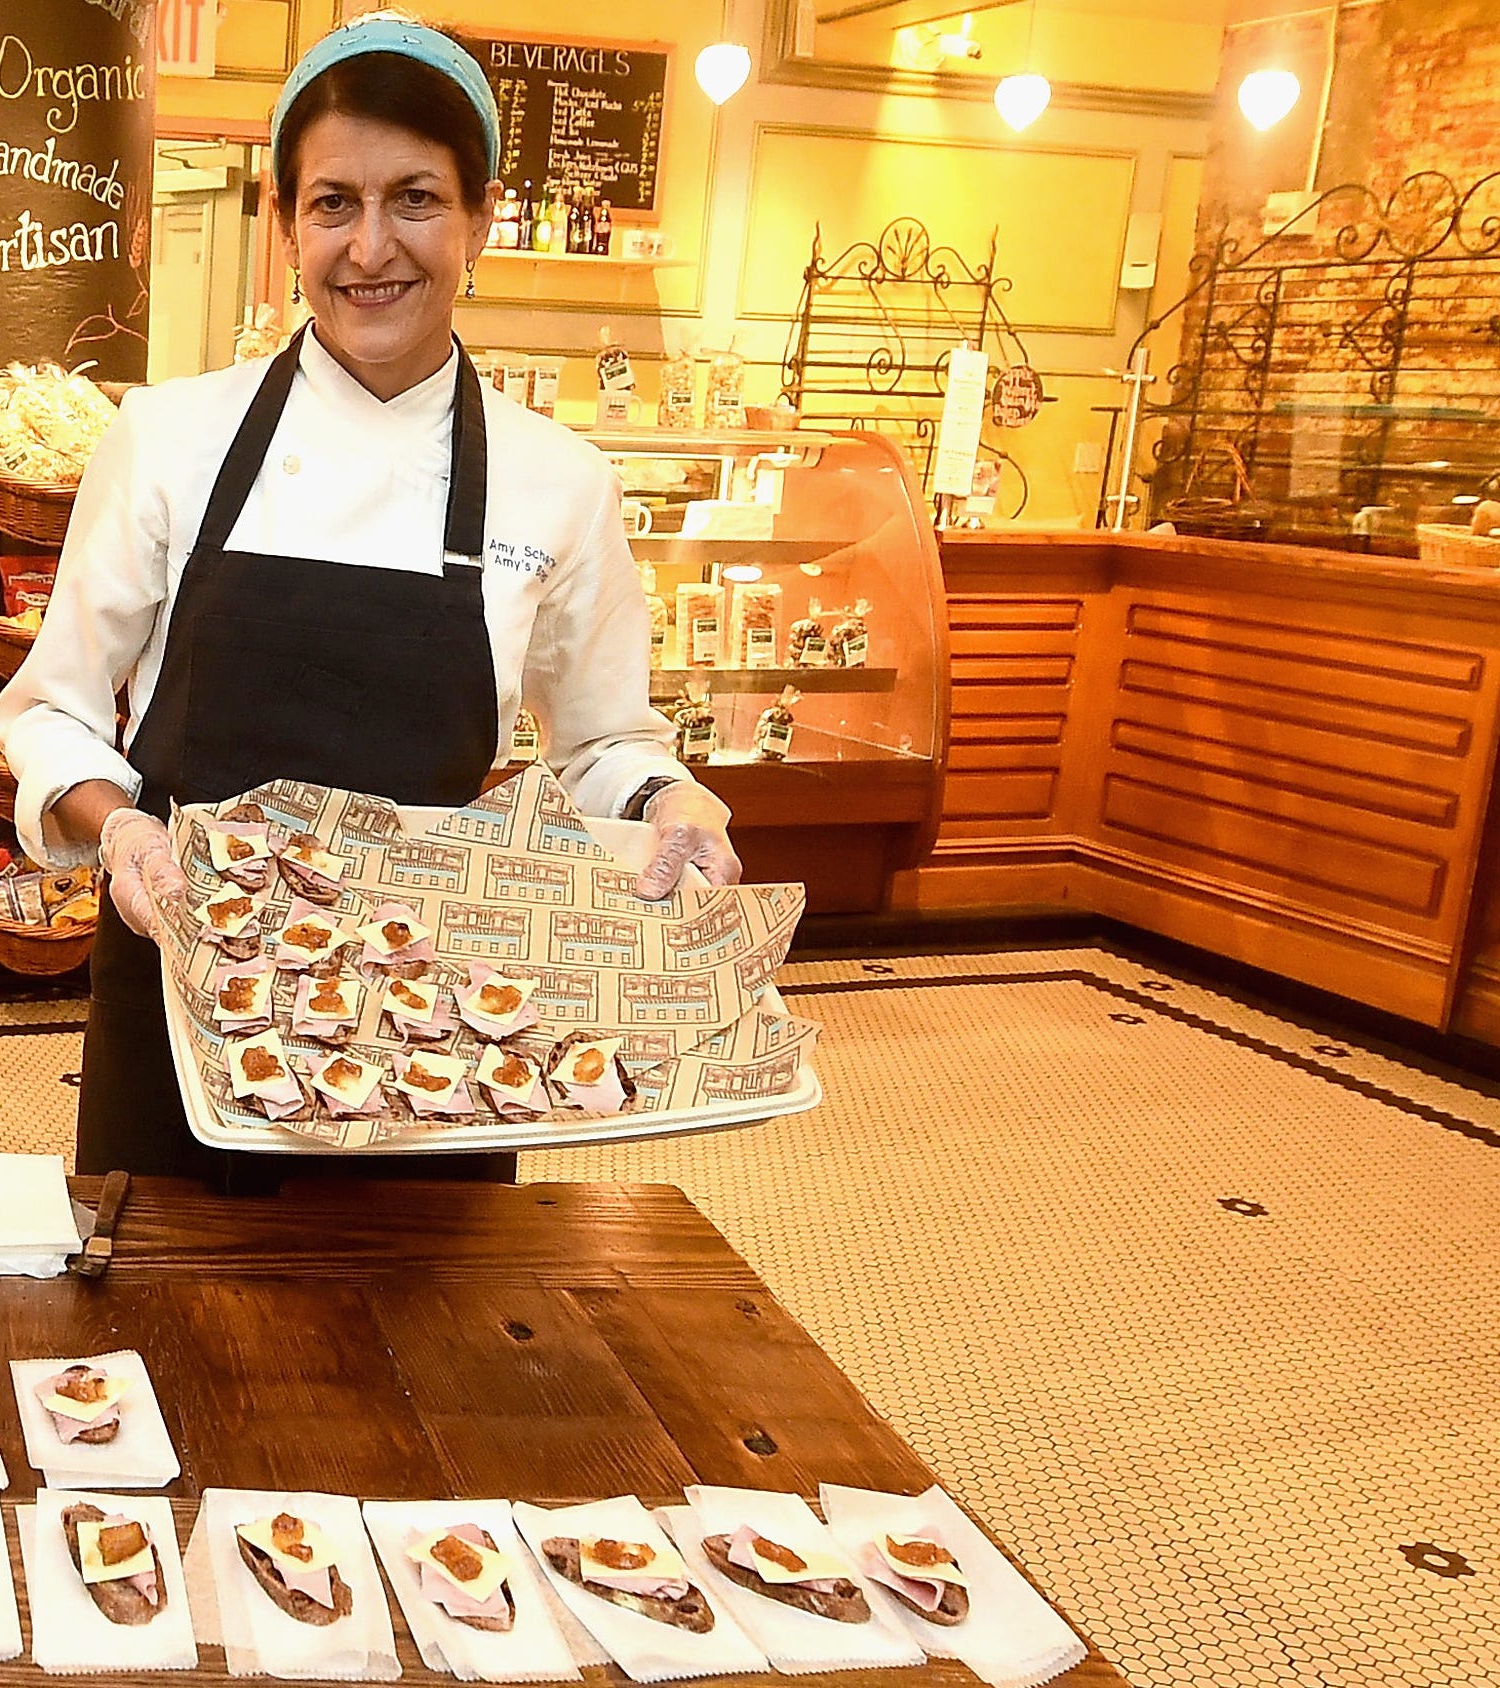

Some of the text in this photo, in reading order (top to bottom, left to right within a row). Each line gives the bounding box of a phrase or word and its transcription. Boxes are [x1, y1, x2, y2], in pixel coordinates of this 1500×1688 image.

[157, 0, 206, 62] XIT
[490, 42, 631, 76] BEVERAGES
[489, 539, 515, 556] Amy
[495, 555, 531, 571] Amy's
